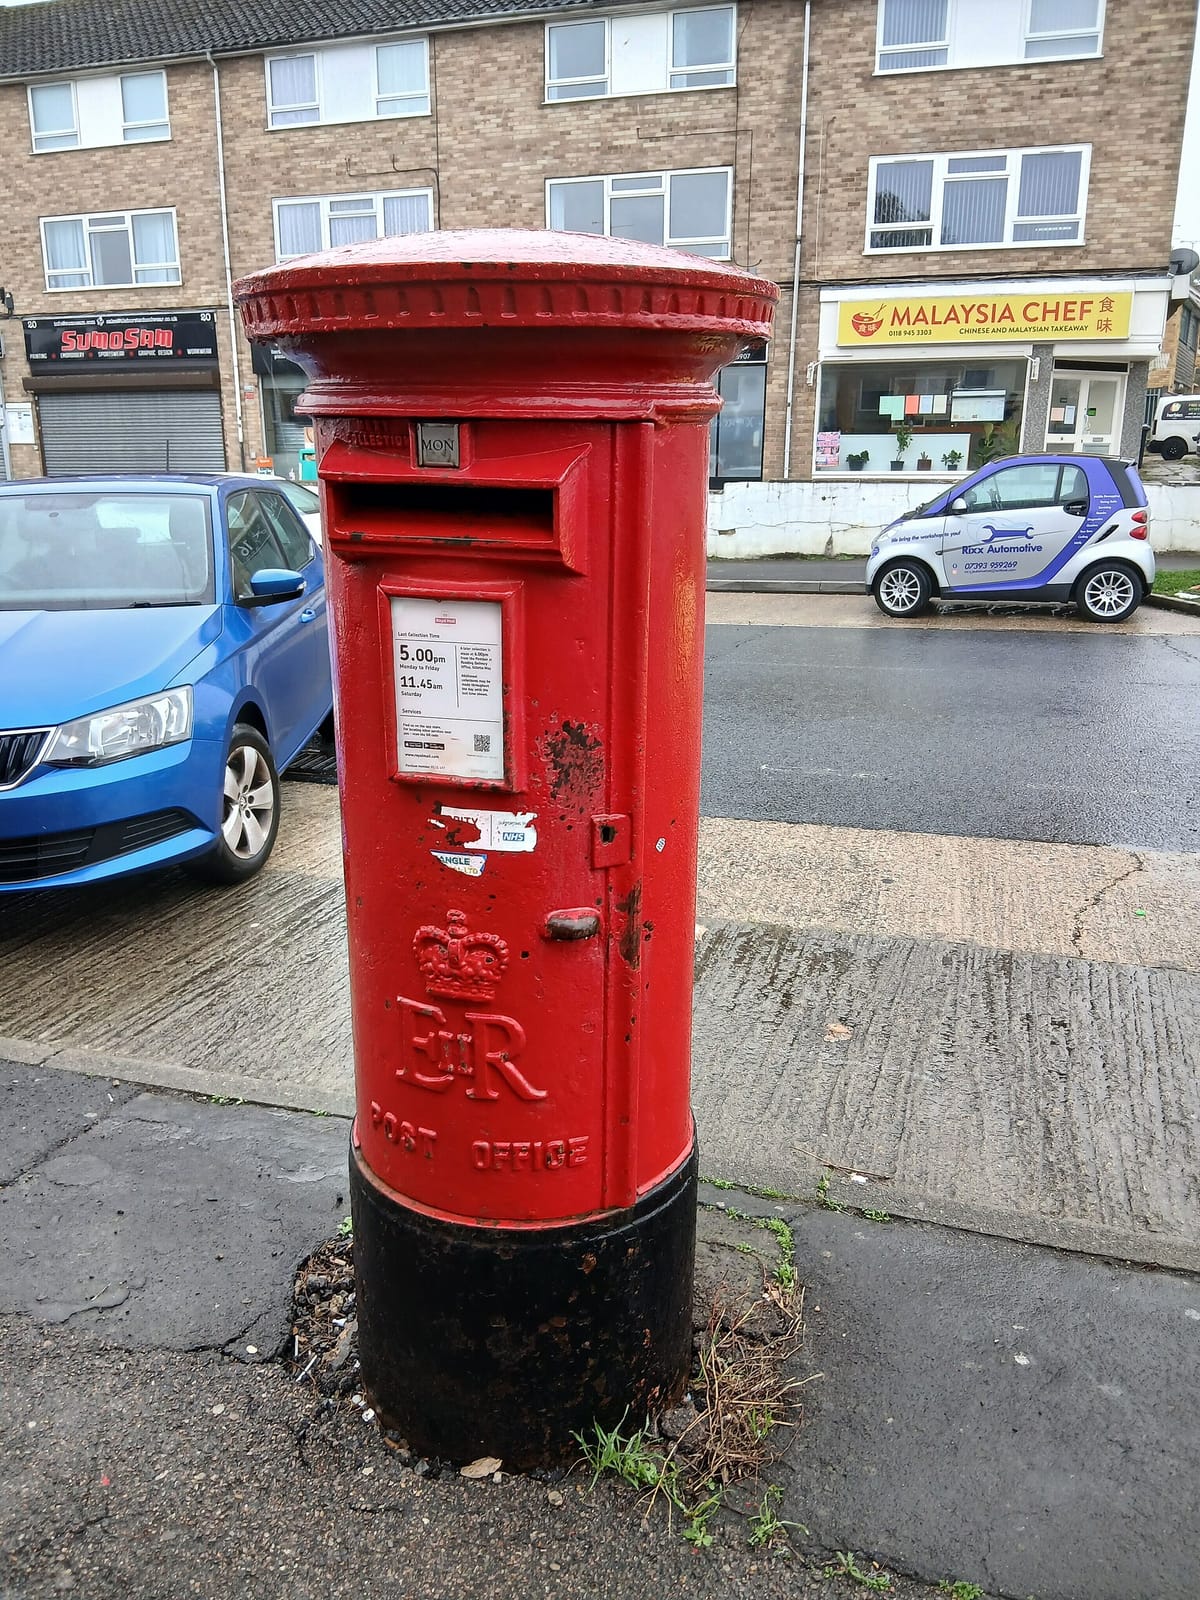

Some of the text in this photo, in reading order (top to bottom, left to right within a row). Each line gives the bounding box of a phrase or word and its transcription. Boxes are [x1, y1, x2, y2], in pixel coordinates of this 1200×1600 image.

[200, 312, 211, 322] 20
[890, 300, 1094, 327] MALAYSIA CHEF
[27, 320, 37, 329] 20
[959, 324, 1088, 335] CHINESE AND MALAYSIAN TAKEAWAY
[422, 439, 455, 451] MON
[920, 533, 944, 541] workshop
[962, 543, 1043, 555] Rixx Automotive
[964, 561, 1018, 570] 07393 959269
[400, 644, 446, 664] 5.00pm
[400, 675, 443, 690] 11.45am
[400, 690, 422, 698] Saturday
[503, 832, 524, 841] NHS
[464, 866, 478, 875] LTD
[371, 1100, 589, 1170] POST OFFICE
